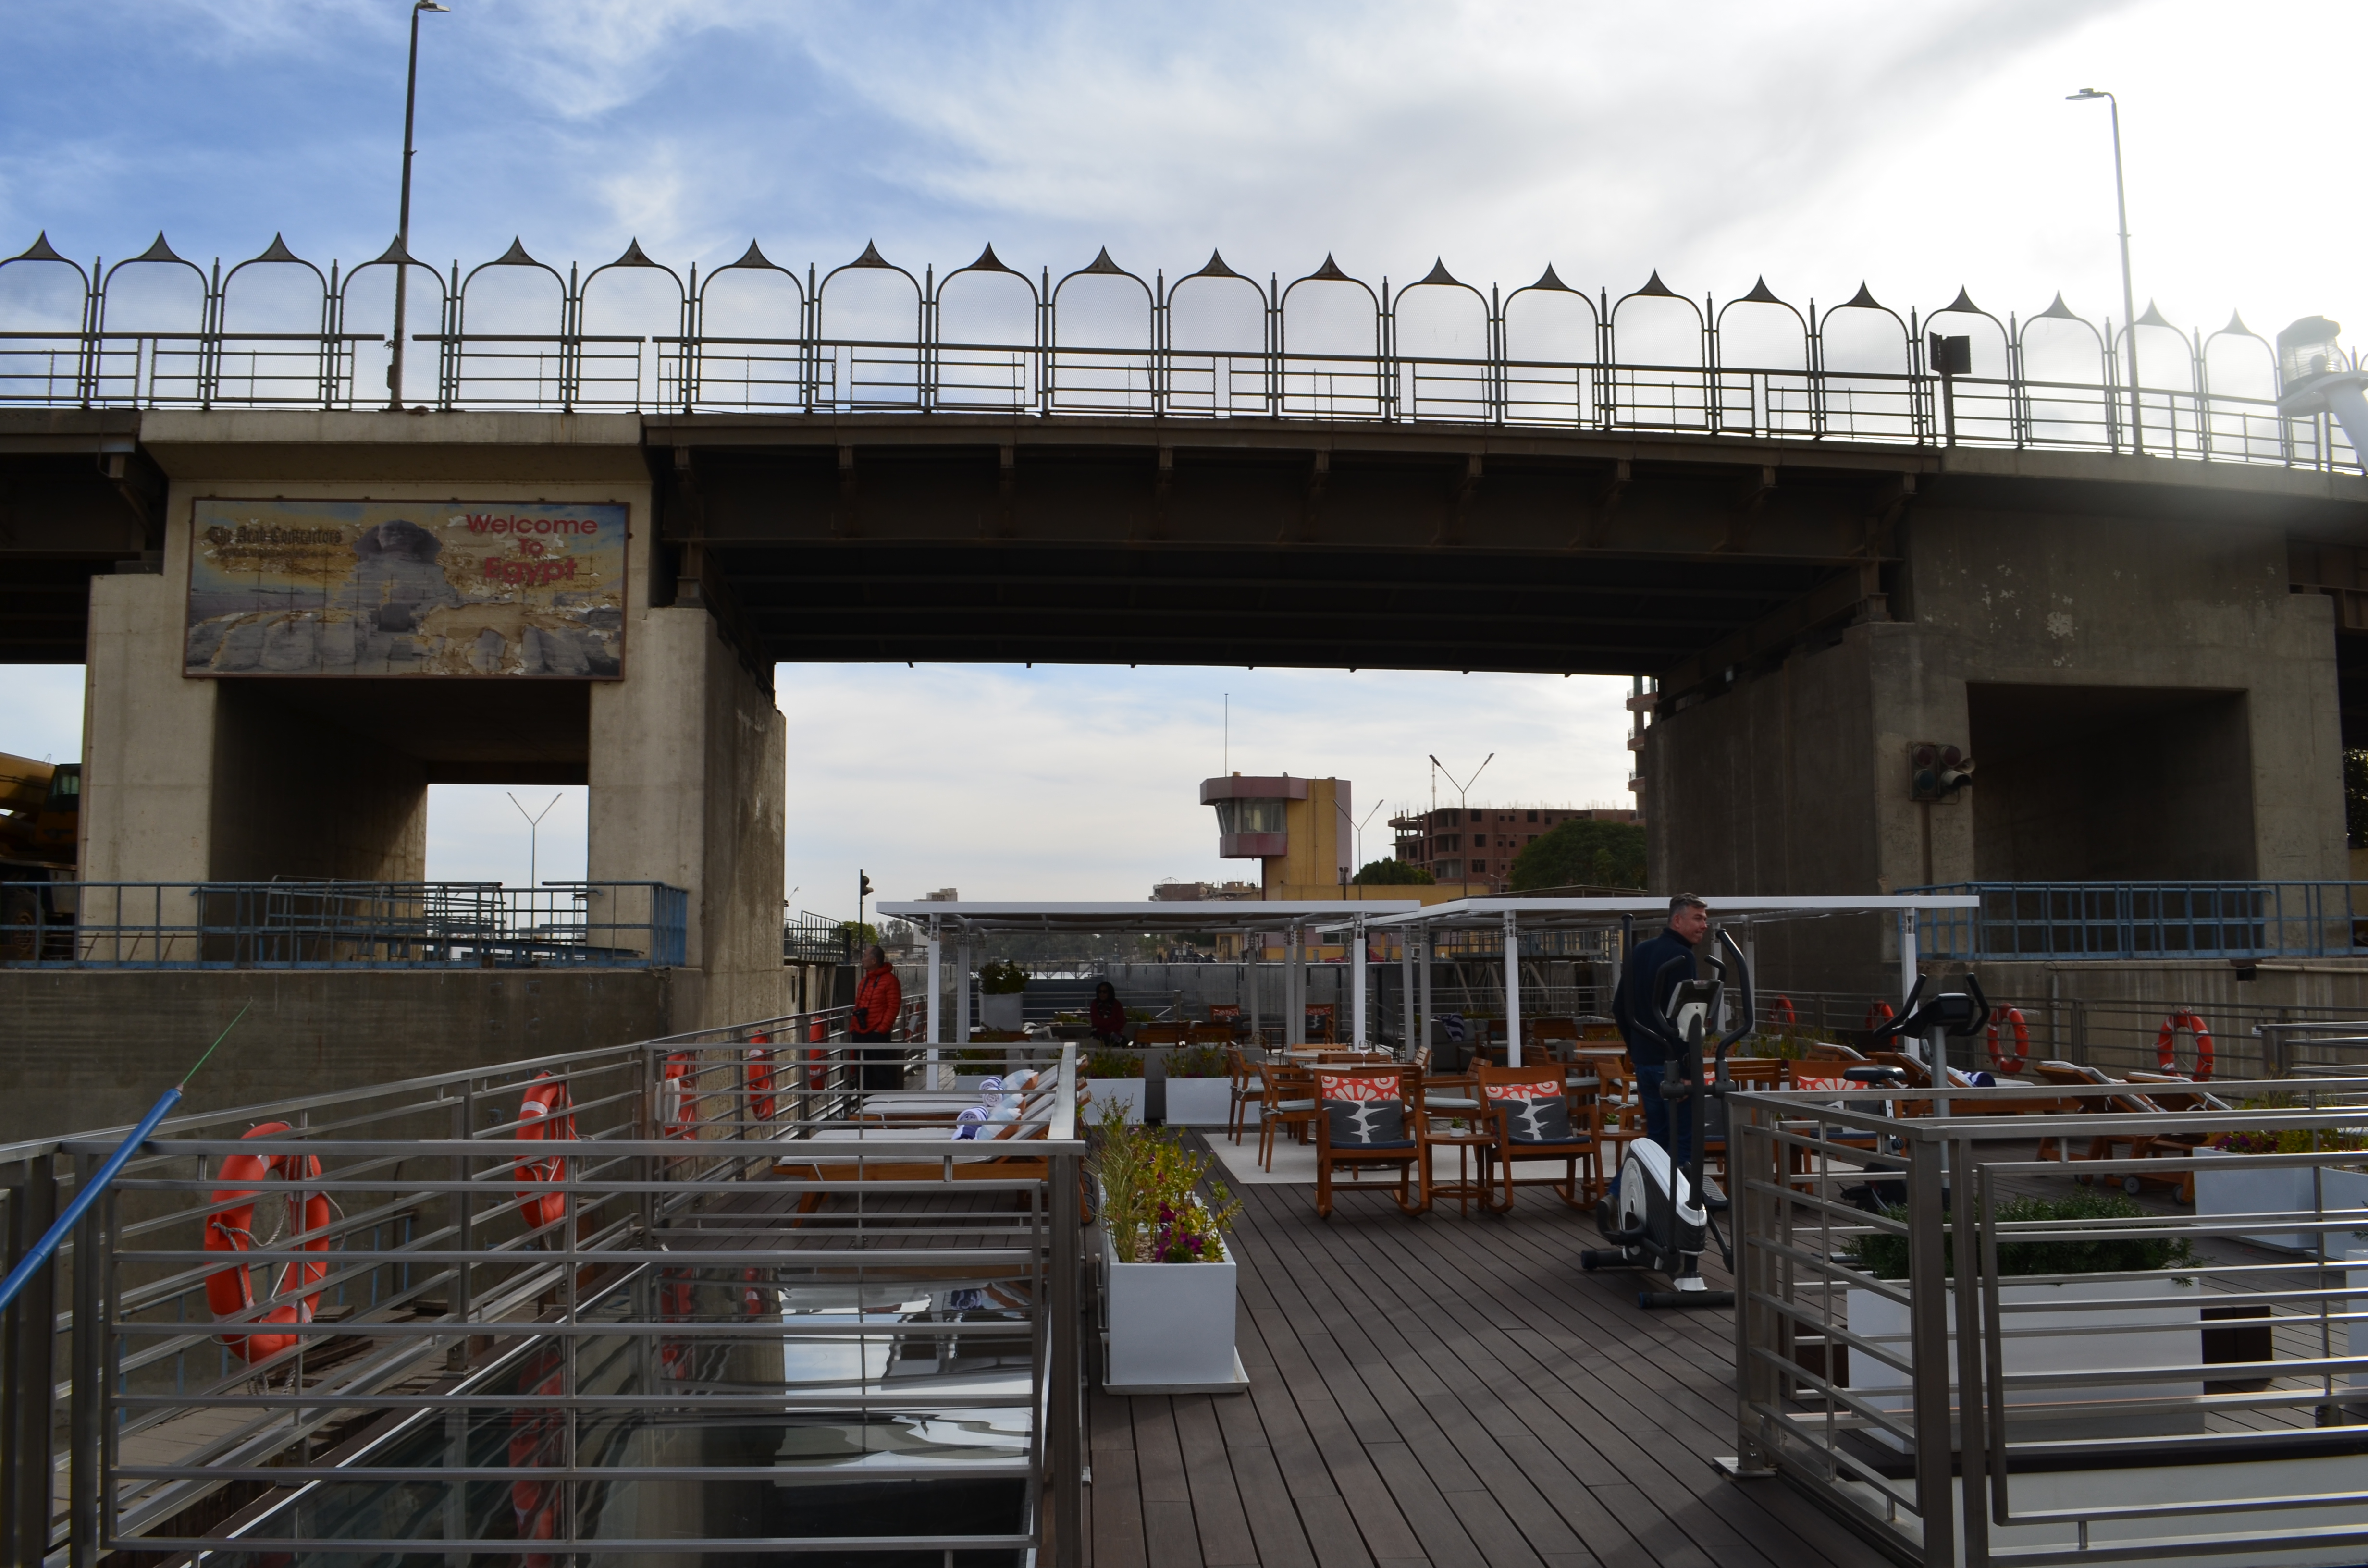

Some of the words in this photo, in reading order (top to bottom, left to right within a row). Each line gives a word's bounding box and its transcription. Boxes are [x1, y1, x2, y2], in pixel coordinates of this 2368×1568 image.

[466, 514, 598, 534] Welcome
[236, 526, 266, 543] Arab
[270, 526, 342, 544] Contractors
[518, 538, 544, 556] To
[484, 557, 577, 585] Egypt
